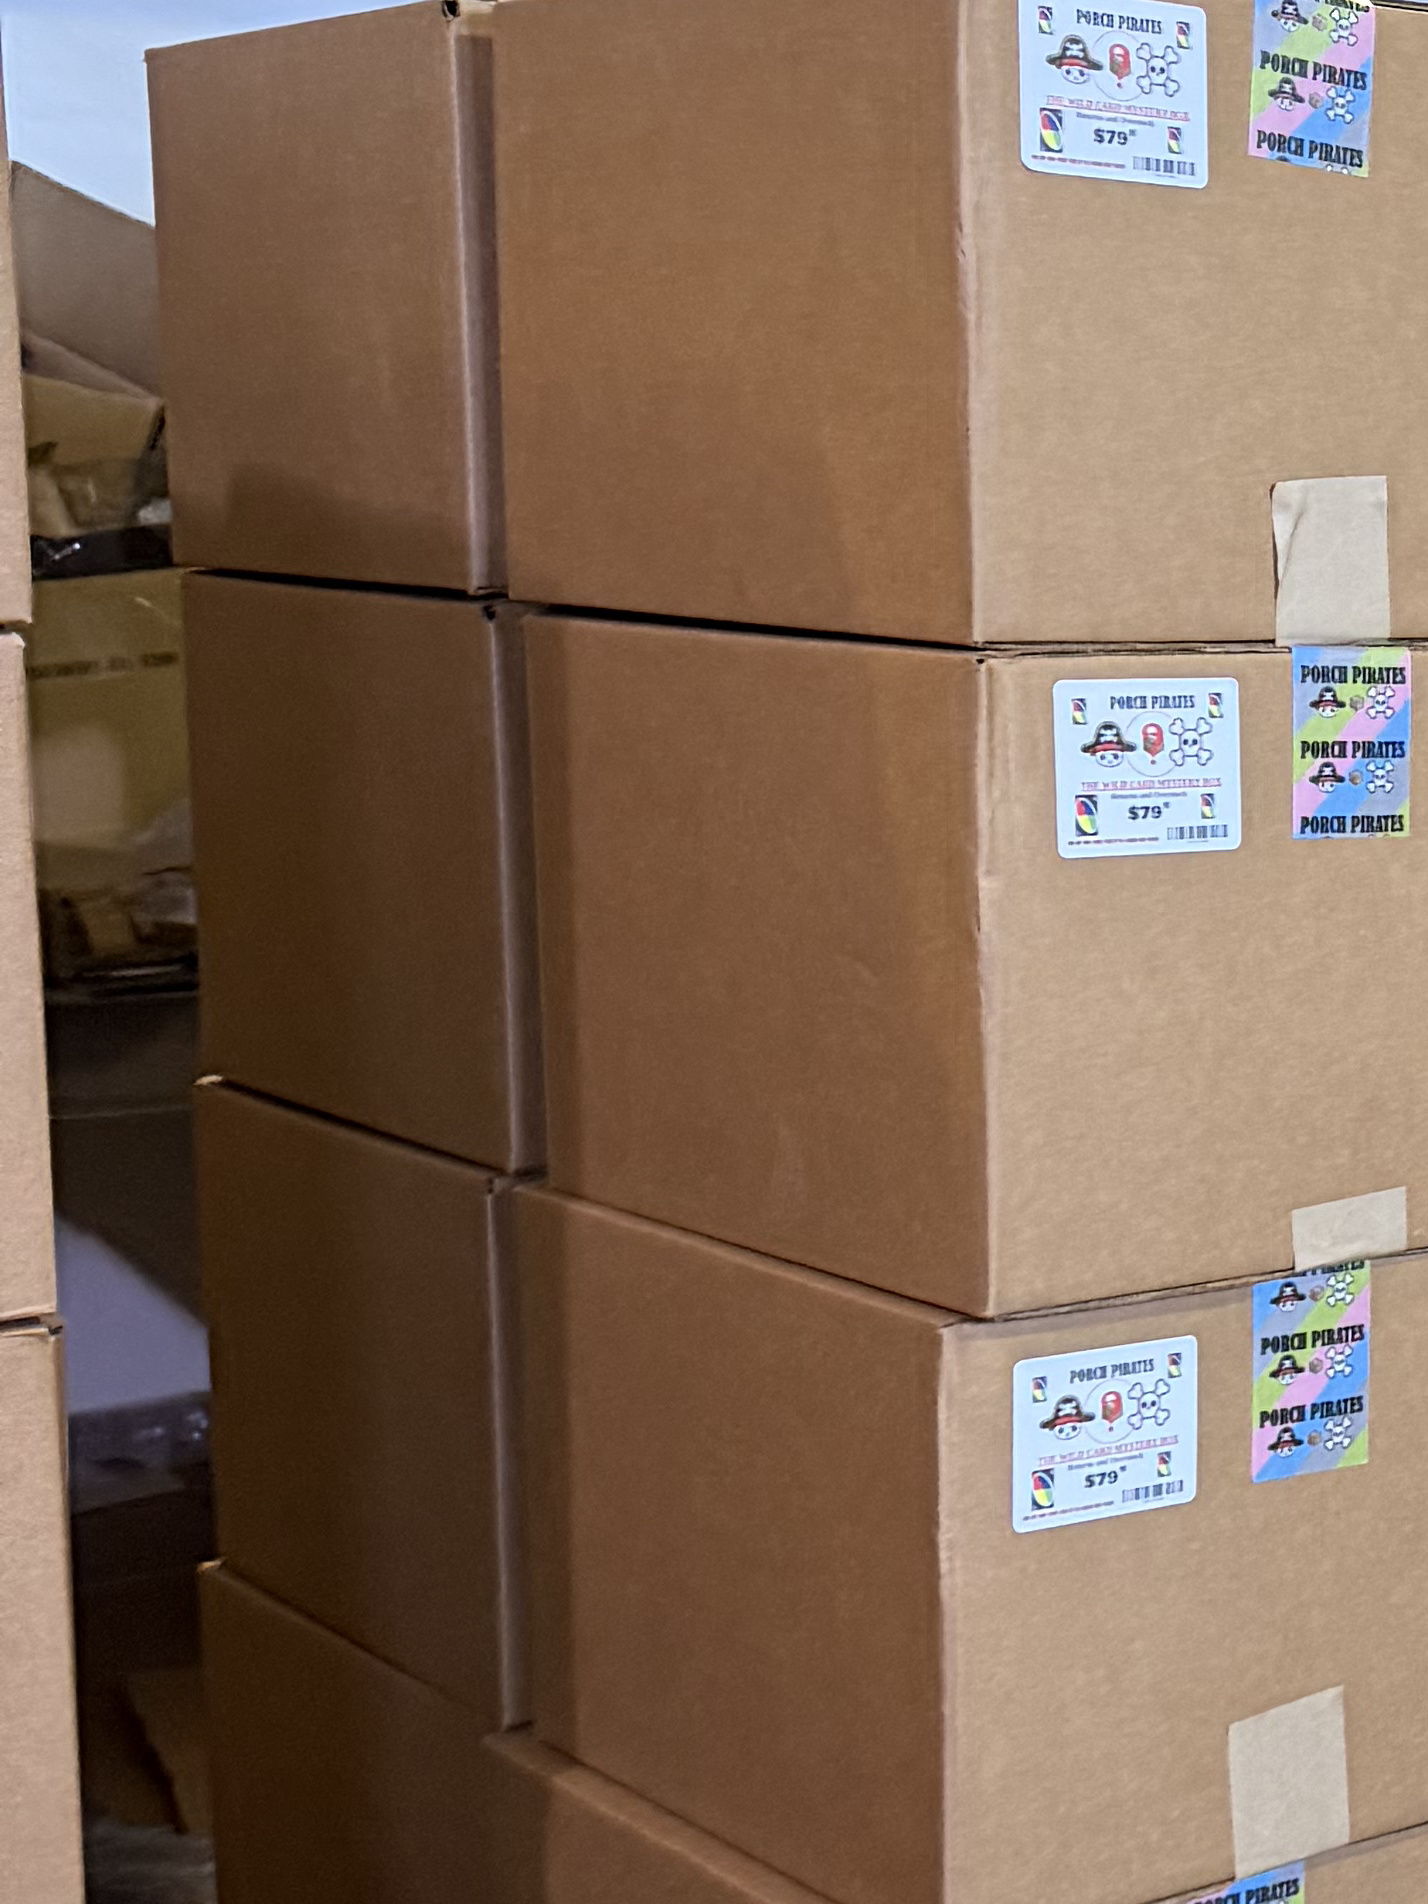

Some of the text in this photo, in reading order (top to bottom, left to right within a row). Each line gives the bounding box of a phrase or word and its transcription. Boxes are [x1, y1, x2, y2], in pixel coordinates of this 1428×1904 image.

[1076, 8, 1162, 35] PORCH PIRATES
[1259, 50, 1367, 91] PORCH PIRATES
[1256, 129, 1364, 168] PORCH PIRATES
[1300, 665, 1406, 685] PORCH PIRATES
[1110, 694, 1195, 709] PORCH PIRATES
[1300, 740, 1406, 759] PORCH PIRATES
[1300, 814, 1404, 835] PORCH PIRATES
[1260, 1323, 1365, 1356] PORCH PIRATES
[1069, 1359, 1155, 1384] PORCH PIRATES
[1259, 1395, 1364, 1428] PORCH PIRATES
